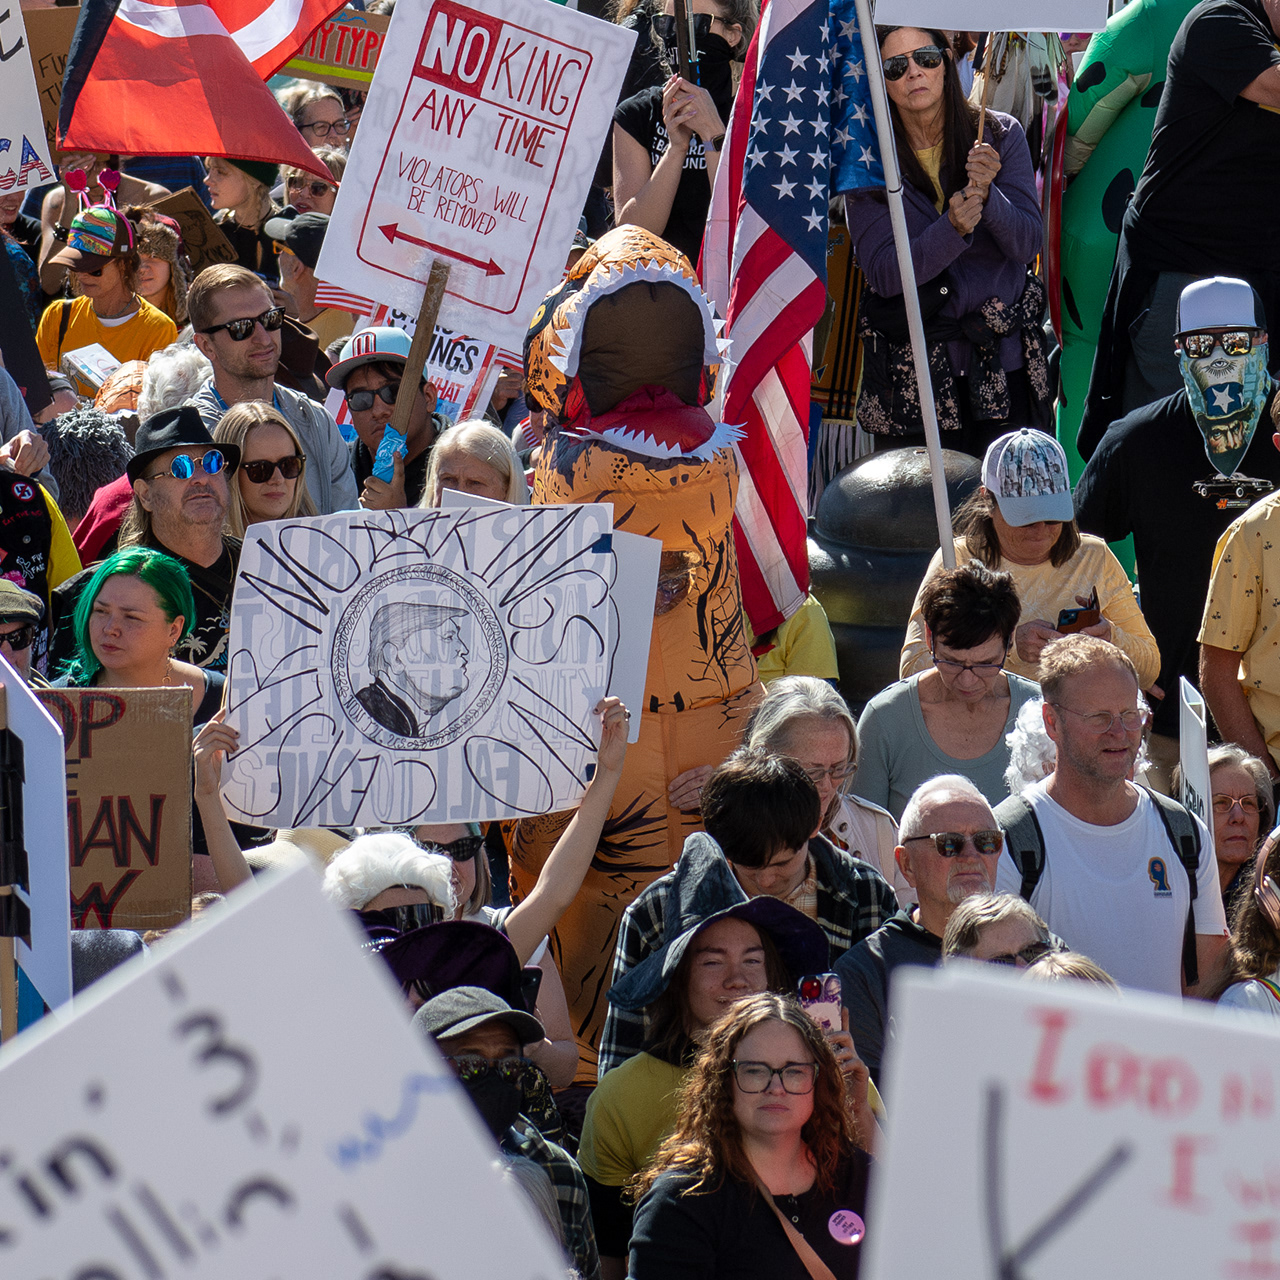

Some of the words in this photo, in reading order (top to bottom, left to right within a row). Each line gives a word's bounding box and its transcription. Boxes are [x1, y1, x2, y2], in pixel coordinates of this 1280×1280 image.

[422, 8, 491, 85] NO
[492, 36, 584, 117] KING
[411, 88, 477, 139] ANY
[493, 111, 556, 168] TIME
[398, 151, 484, 205] VIOLATORS
[493, 185, 529, 222] WILL
[407, 186, 431, 215] BE
[433, 195, 497, 236] REMOVED
